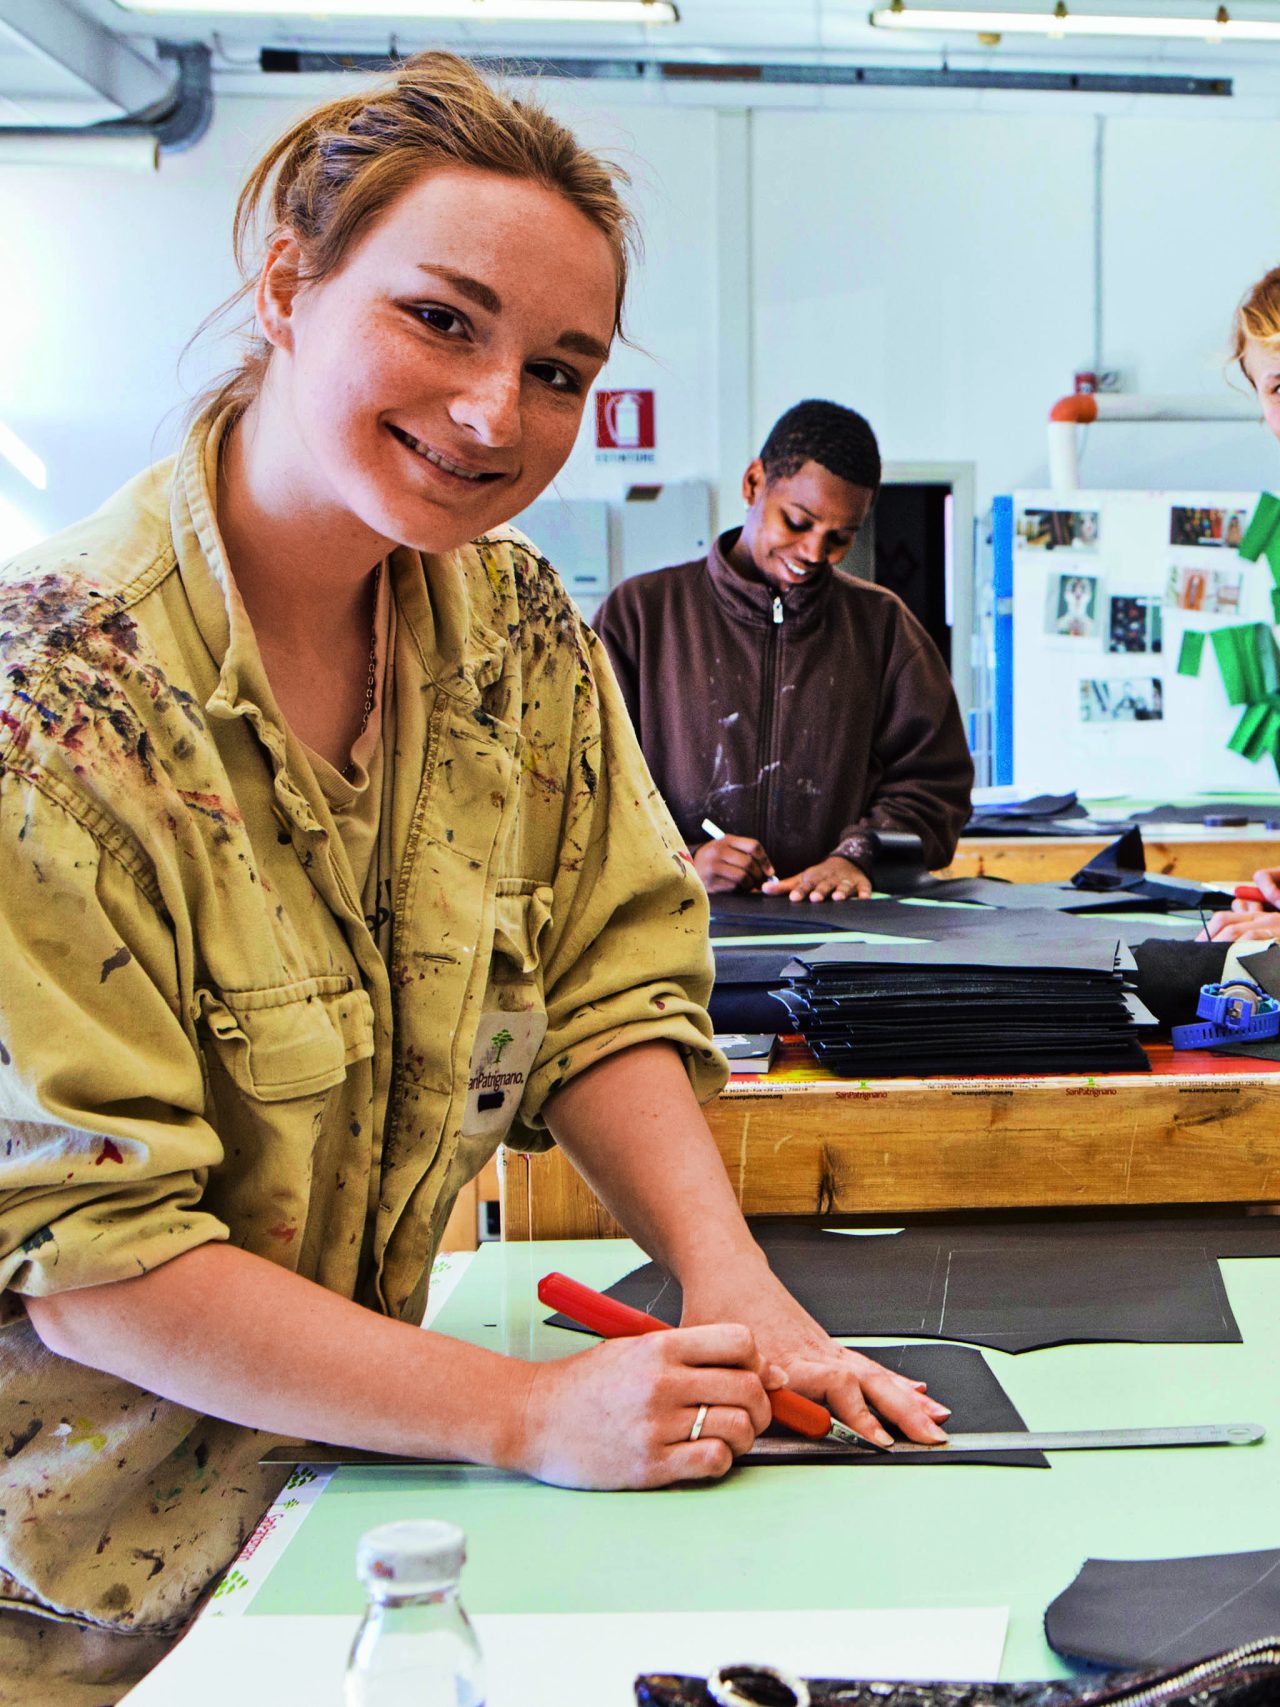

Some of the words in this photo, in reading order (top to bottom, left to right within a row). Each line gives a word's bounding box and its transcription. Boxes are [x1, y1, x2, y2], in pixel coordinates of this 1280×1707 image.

[468, 1072, 524, 1091] anPatrignano.
[835, 1091, 888, 1100] SanPatrignano
[1065, 1088, 1117, 1097] SanPatrignano
